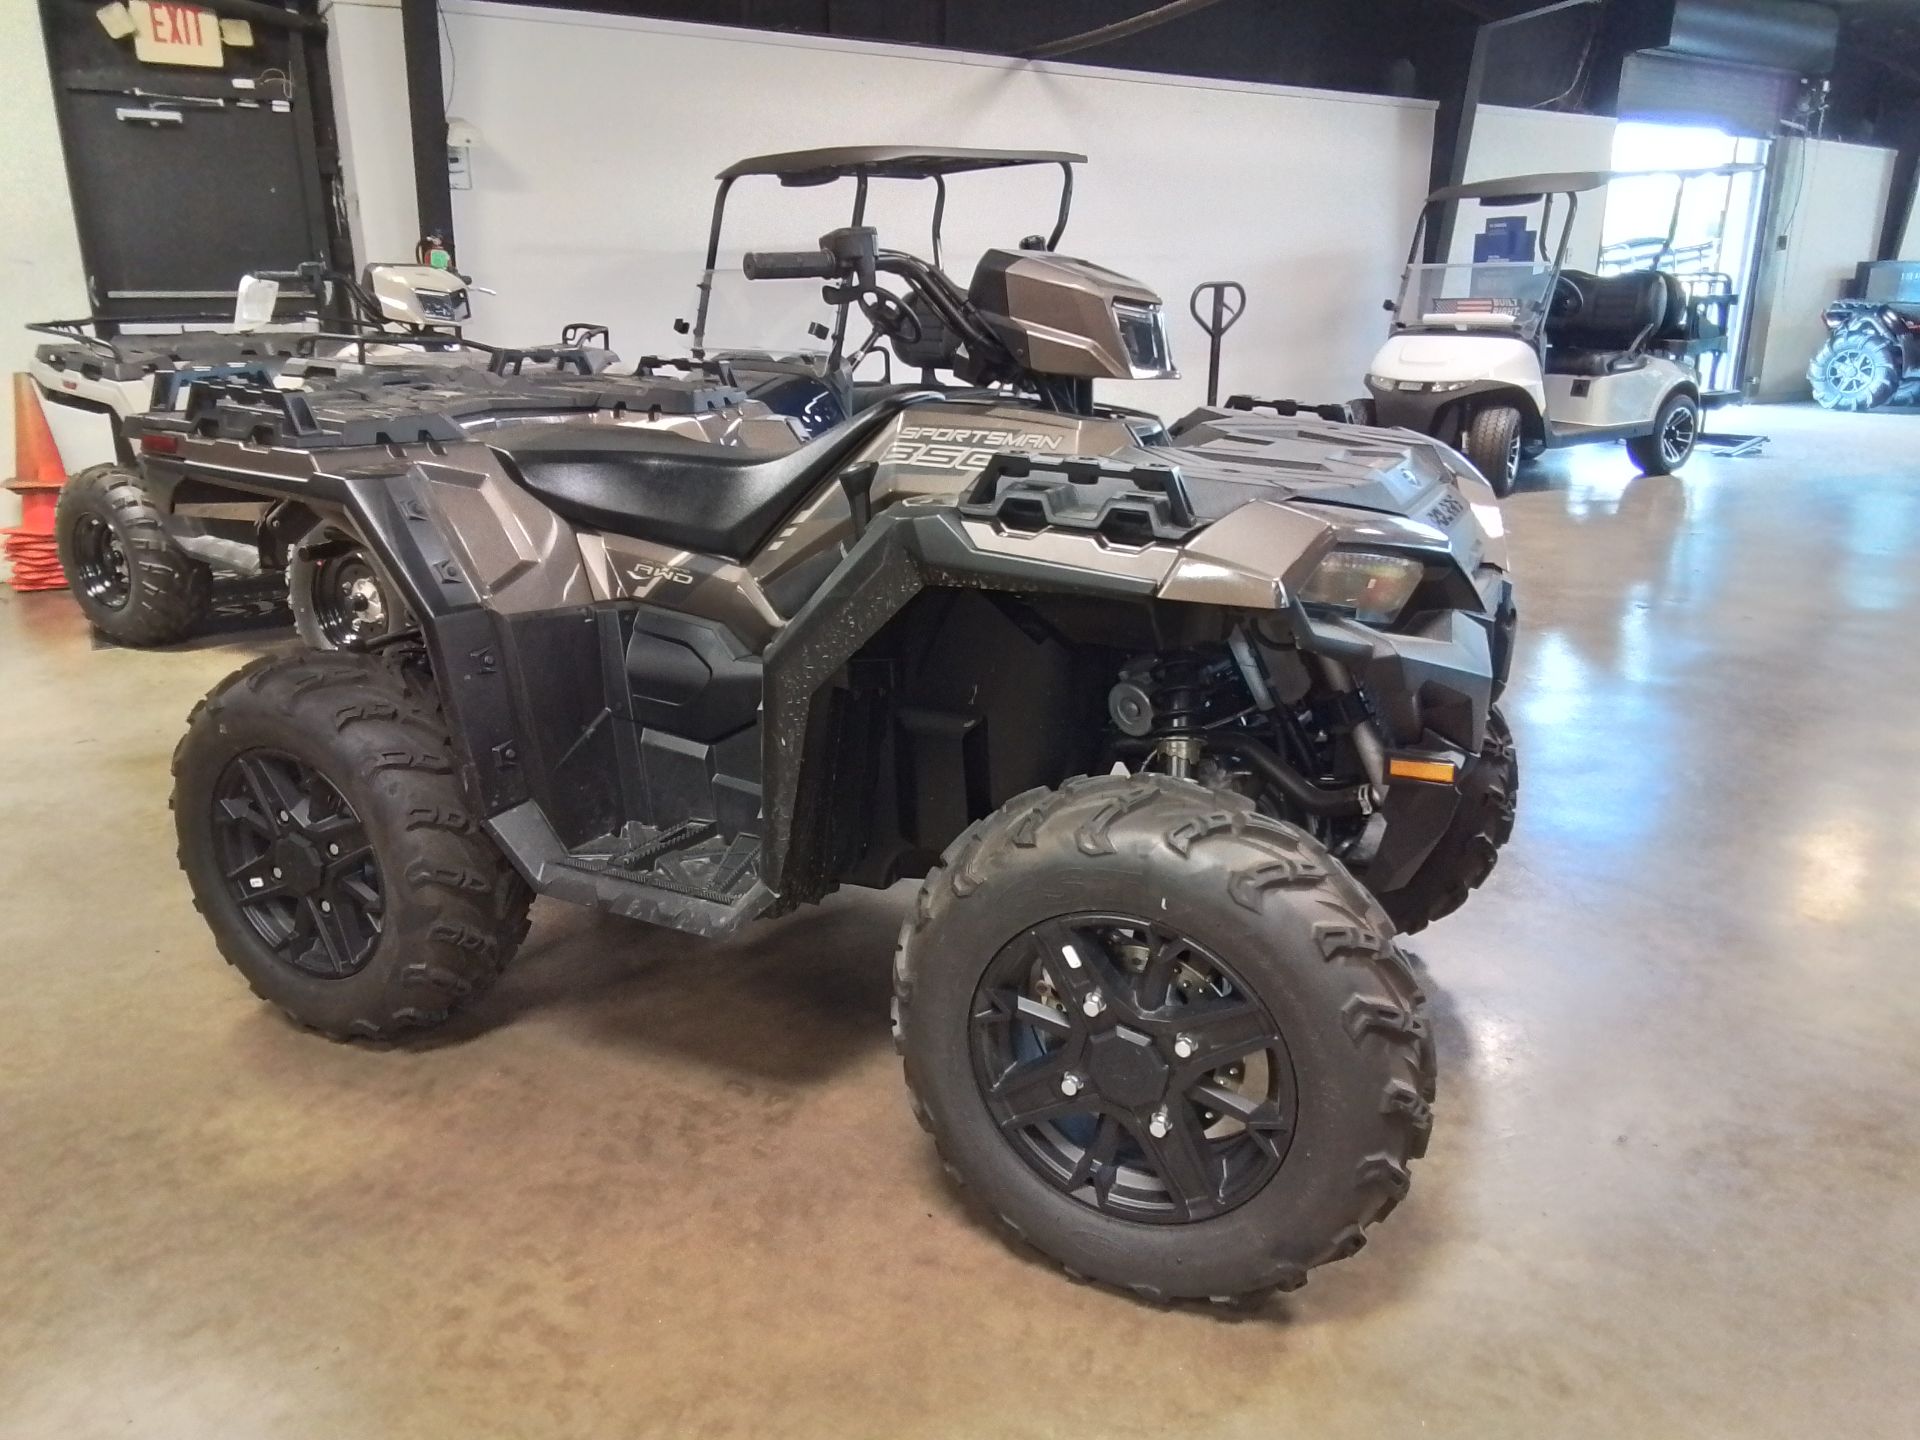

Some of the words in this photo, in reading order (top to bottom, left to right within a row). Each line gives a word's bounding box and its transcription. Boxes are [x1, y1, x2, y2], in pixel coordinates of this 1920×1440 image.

[150, 3, 203, 46] EXIT
[1493, 299, 1518, 307] BUILT
[899, 427, 1063, 449] SPORTSMAN
[633, 563, 694, 585] AWD
